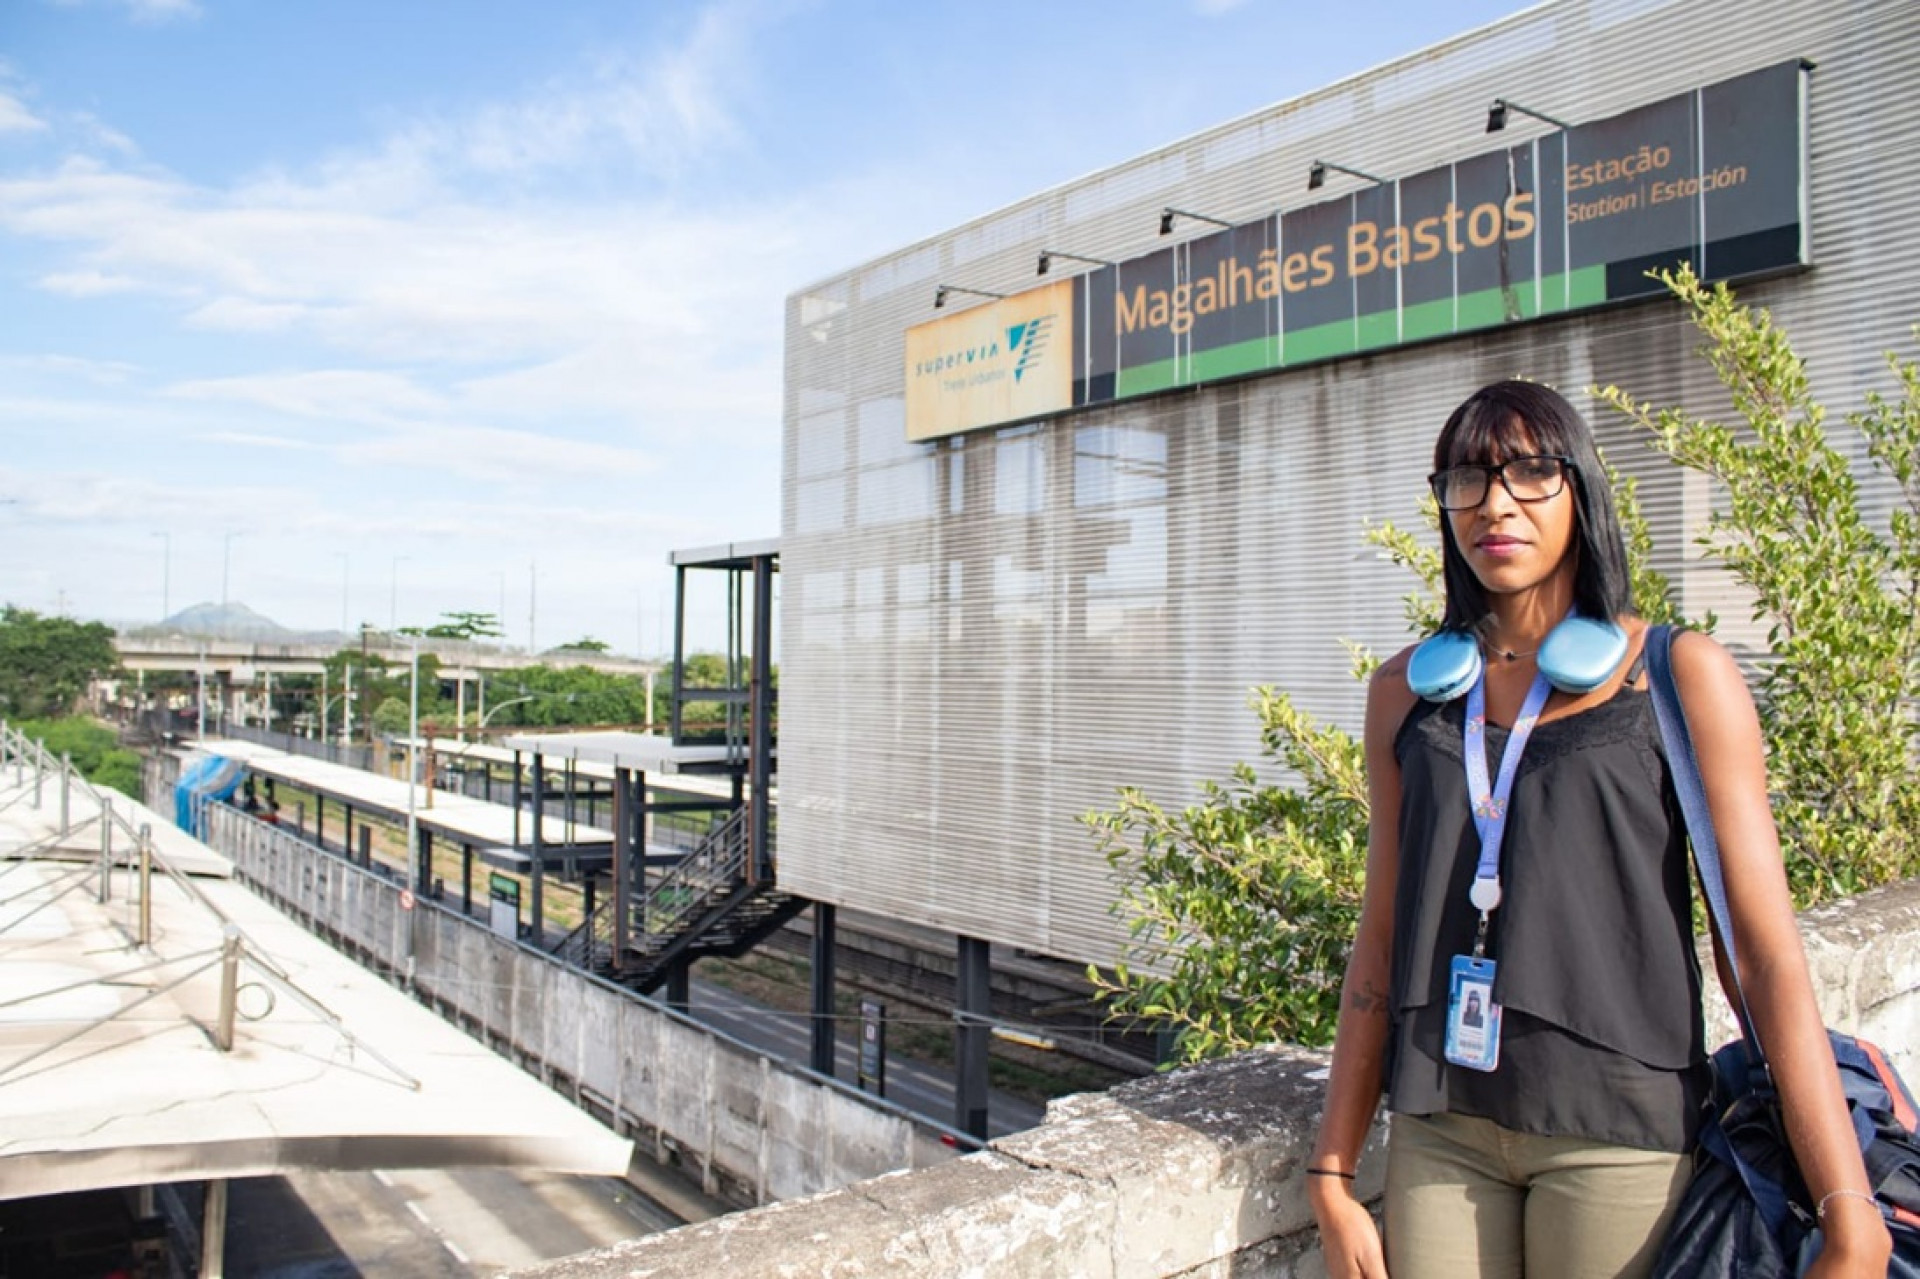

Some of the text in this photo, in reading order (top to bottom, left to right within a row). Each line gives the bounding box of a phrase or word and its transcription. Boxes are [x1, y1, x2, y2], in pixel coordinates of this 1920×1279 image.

[1566, 146, 1671, 191] Estação
[1567, 166, 1748, 224] Station Estación
[1116, 192, 1536, 335] Magalhães Bastos
